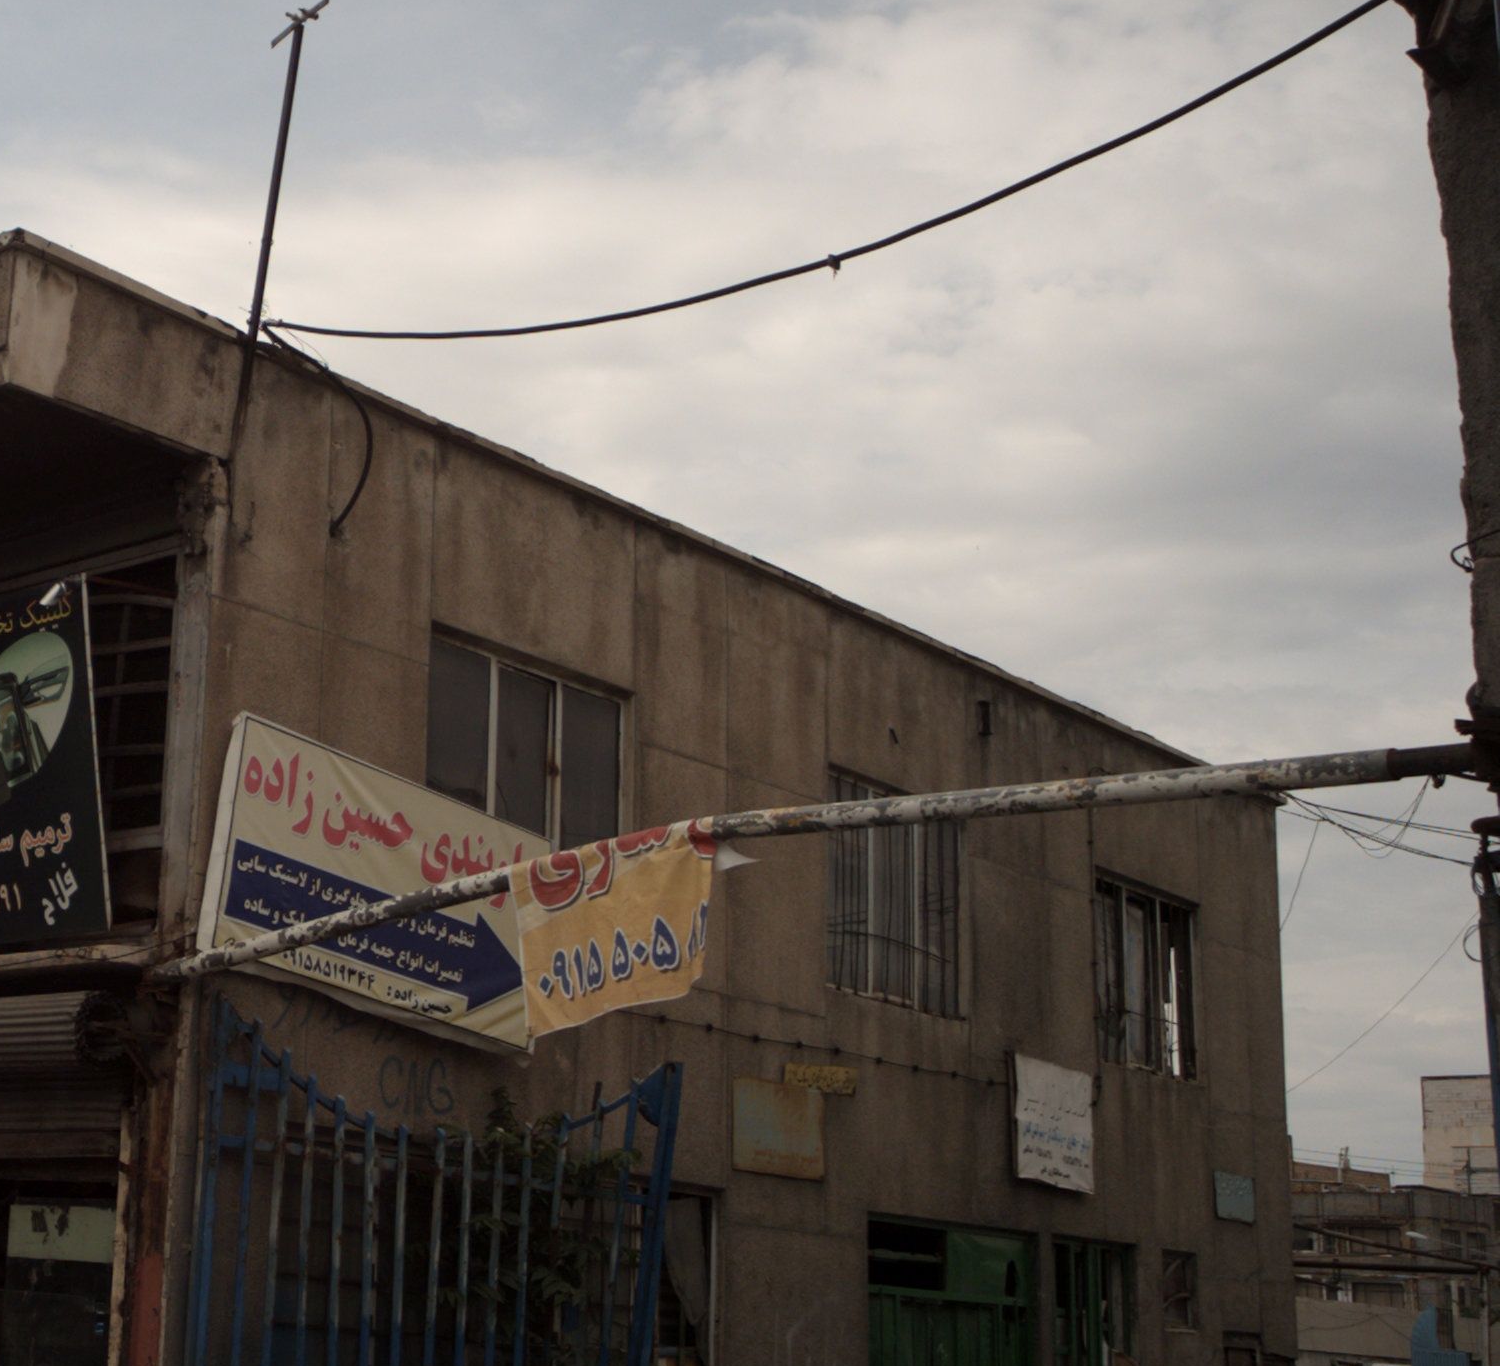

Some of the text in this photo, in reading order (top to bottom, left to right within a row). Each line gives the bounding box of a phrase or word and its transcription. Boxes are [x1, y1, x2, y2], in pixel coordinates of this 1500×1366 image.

[243, 753, 316, 836] زاده
[321, 791, 413, 853] حسین
[18, 811, 74, 867] ترمیم
[236, 857, 268, 874] سایی
[268, 863, 309, 889] لاستیک
[40, 860, 80, 926] فلاح
[308, 879, 322, 897] از
[243, 896, 271, 918] ساده
[271, 910, 281, 926] و
[409, 920, 417, 933] و
[417, 917, 448, 942] فرمان
[448, 927, 476, 949] تنظیم
[336, 932, 464, 984] تعمیرات انواع جعبه فرمان
[538, 937, 606, 1002] ۰۹۱۵
[611, 914, 681, 982] ۵۰۵
[393, 988, 420, 1011] زاده
[422, 1001, 452, 1015] حسین
[378, 1055, 454, 1127] CNG
